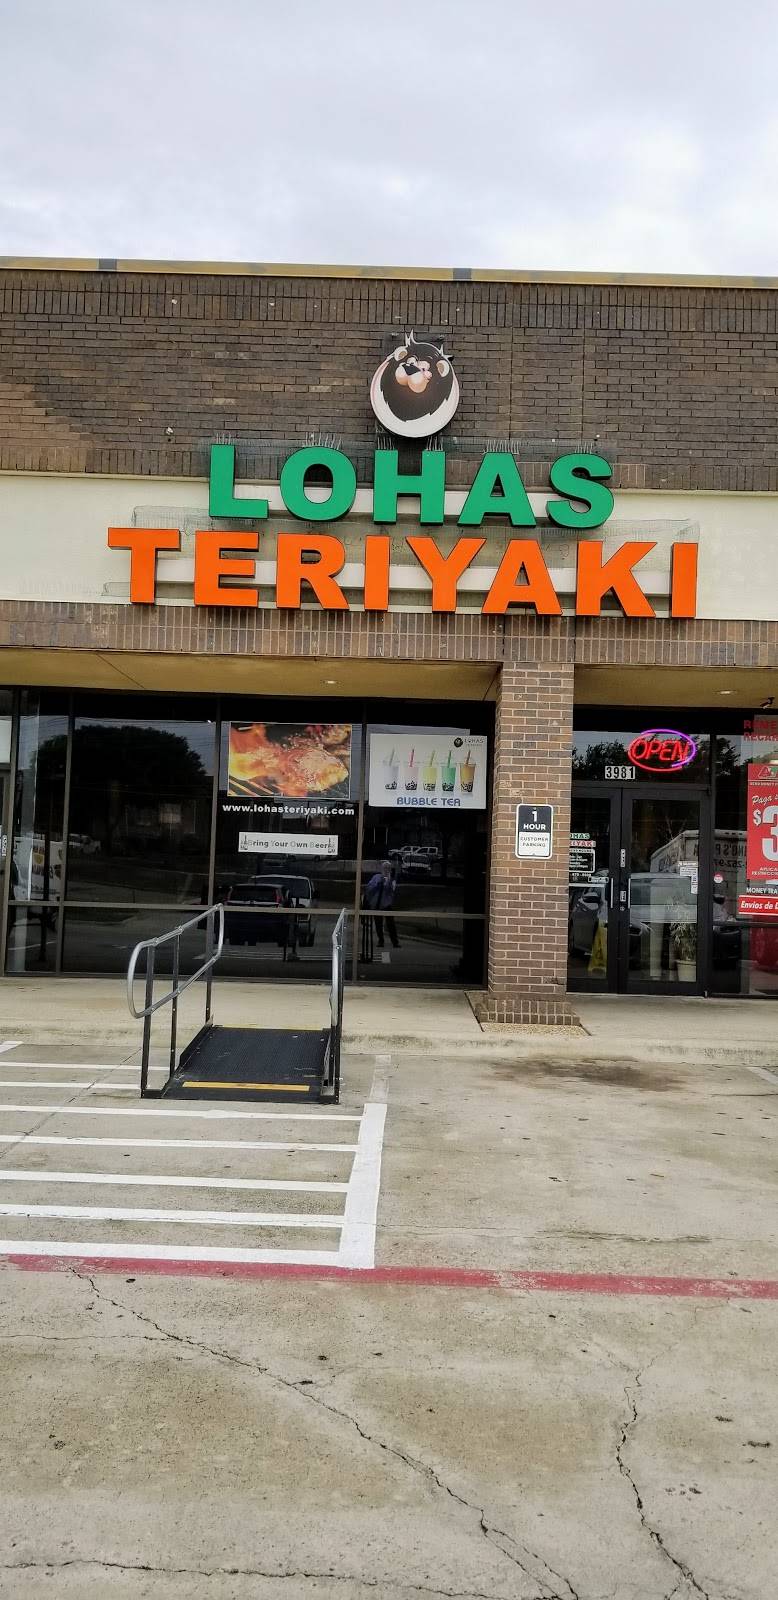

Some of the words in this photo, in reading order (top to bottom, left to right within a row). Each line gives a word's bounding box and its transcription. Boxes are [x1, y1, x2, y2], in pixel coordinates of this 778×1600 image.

[209, 444, 615, 529] LOHAS
[107, 527, 698, 619] TERIYAKI
[632, 738, 689, 761] OPEN
[605, 766, 635, 779] 3981
[396, 796, 438, 806] BUBBLE
[440, 797, 461, 807] TEA
[222, 804, 355, 816] www.lohasteriyaki.com
[532, 810, 538, 823] 1
[248, 839, 269, 849] Bring
[271, 839, 289, 848] Your
[290, 840, 308, 848] Own
[746, 887, 767, 895] MONEY
[740, 900, 763, 910] Envios
[764, 902, 774, 911] de
